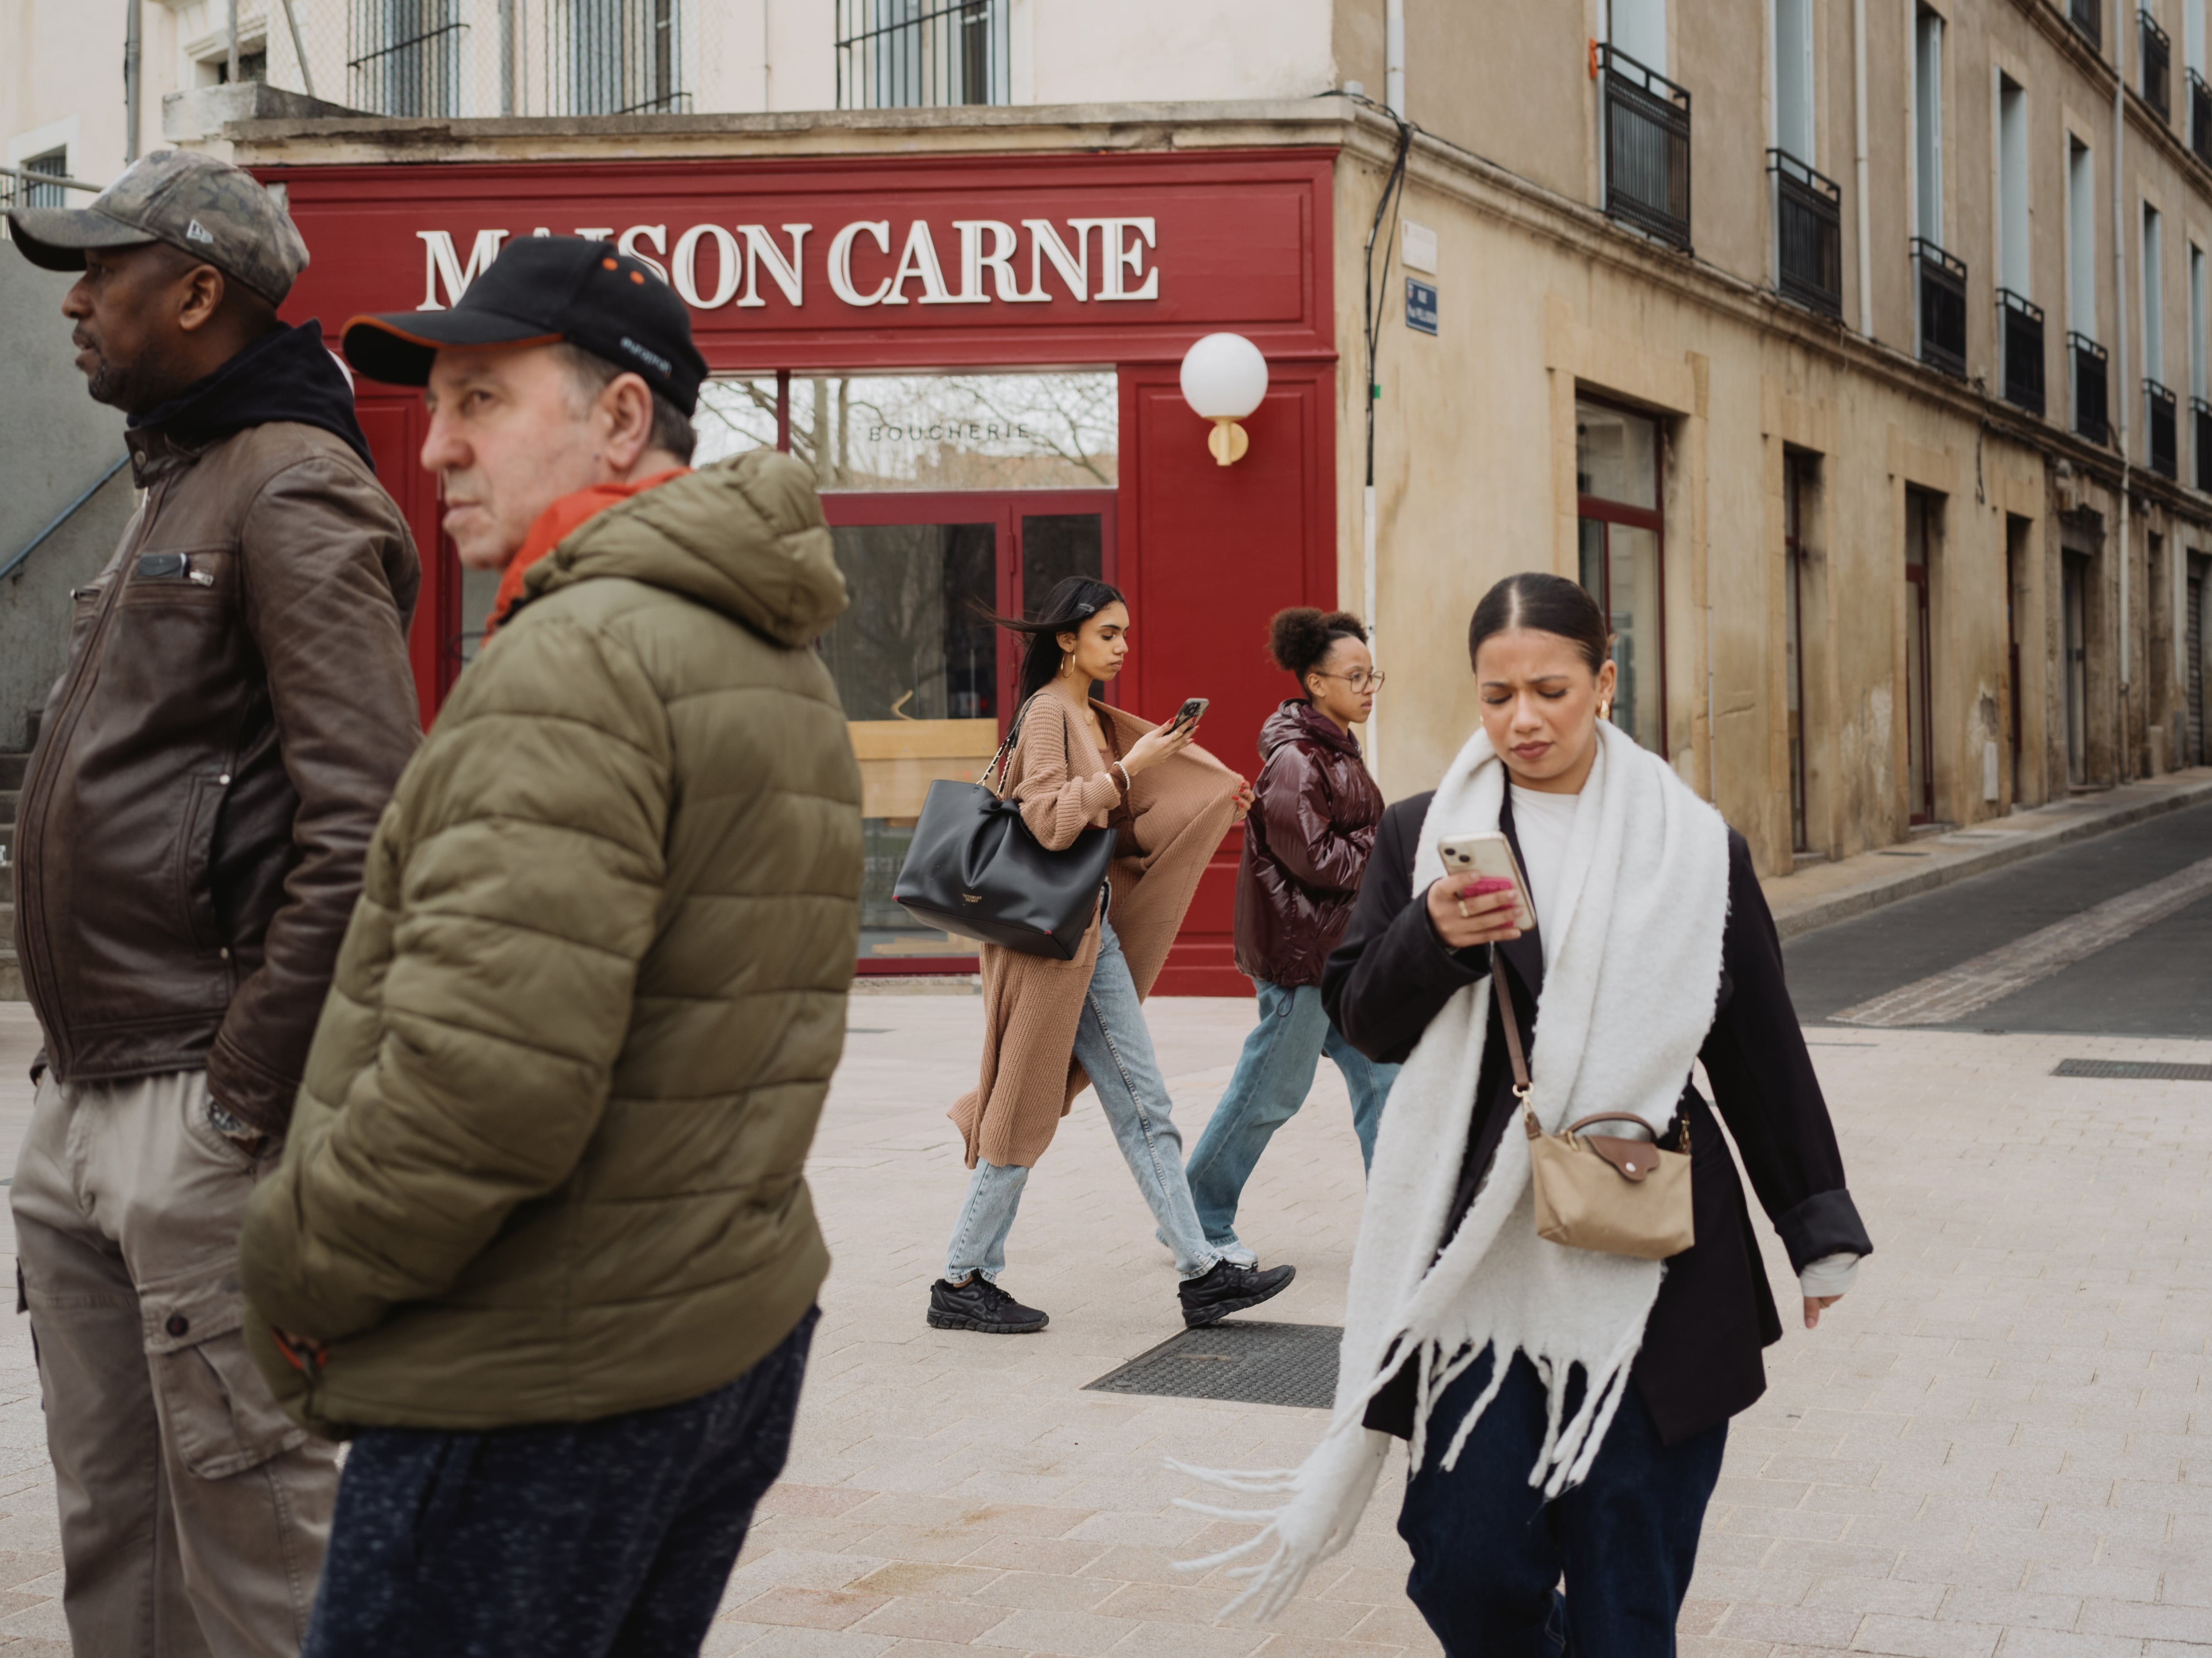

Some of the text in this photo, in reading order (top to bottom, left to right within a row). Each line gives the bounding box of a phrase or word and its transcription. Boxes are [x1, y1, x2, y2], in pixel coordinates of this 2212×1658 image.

[416, 217, 1159, 311] MSON CARNE
[869, 423, 1030, 441] BOUCHERIE
